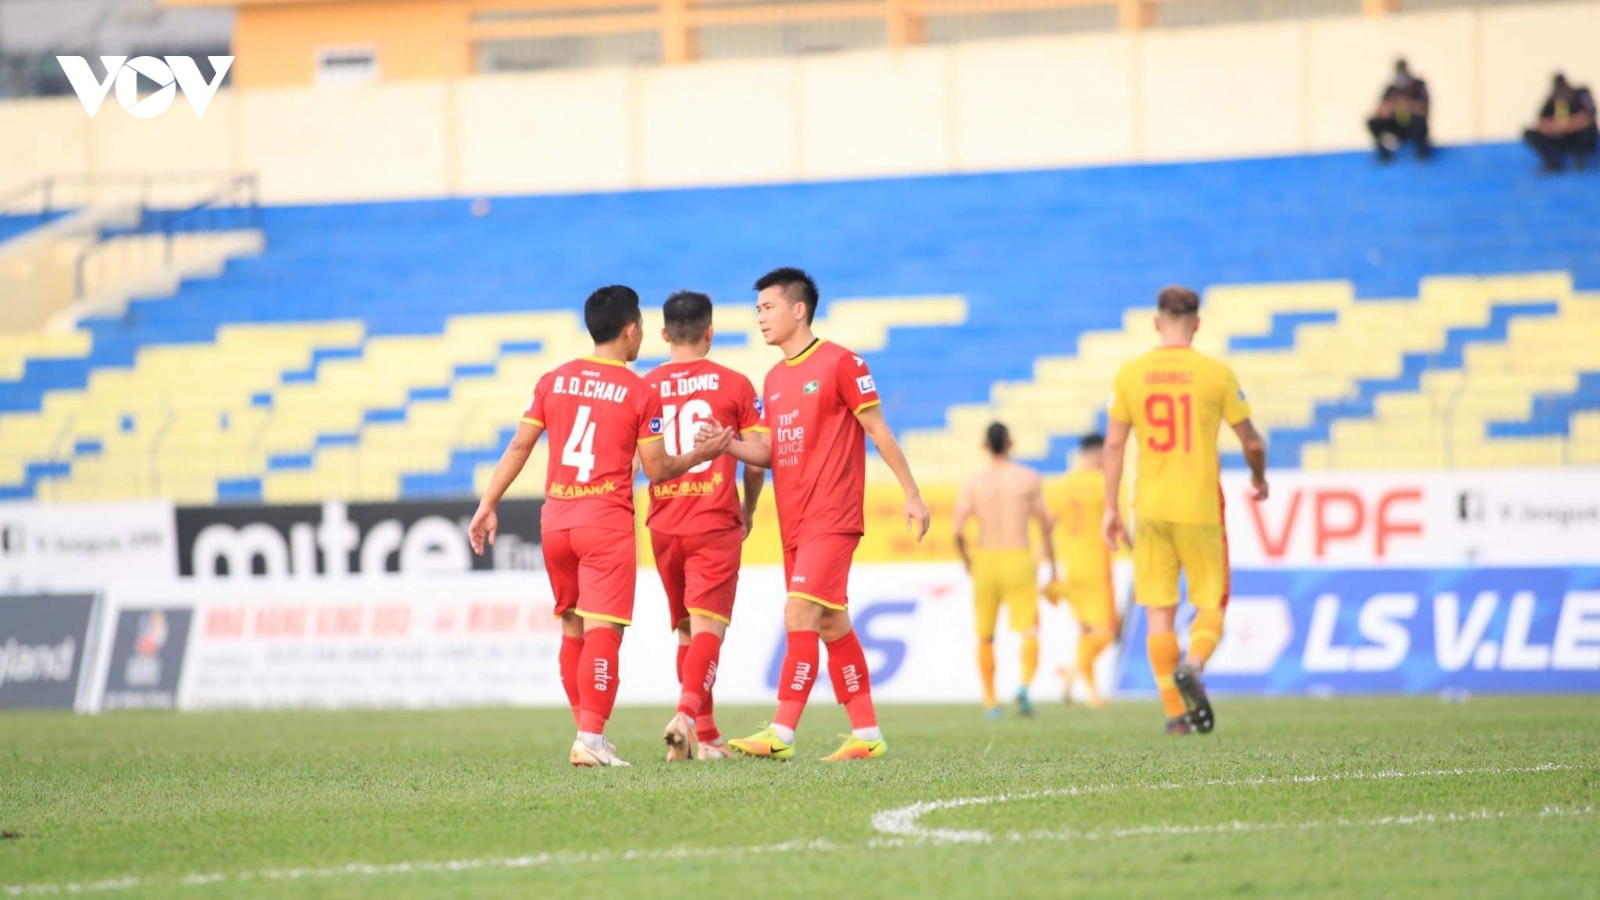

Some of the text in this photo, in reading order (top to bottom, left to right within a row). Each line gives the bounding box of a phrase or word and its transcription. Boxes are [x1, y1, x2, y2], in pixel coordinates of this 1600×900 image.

[860, 379, 874, 392] LS
[662, 399, 713, 474] 16
[777, 426, 804, 442] true
[1145, 394, 1191, 453] 91
[561, 405, 597, 482] 4
[777, 440, 804, 455] JUICE
[779, 455, 798, 467] milk
[192, 500, 473, 576] mitre
[1245, 490, 1423, 559] VPF
[1301, 594, 1418, 673] LS
[594, 658, 612, 691] mitre
[703, 660, 716, 691] mitre
[791, 662, 811, 690] mitre
[842, 664, 862, 692] mitre
